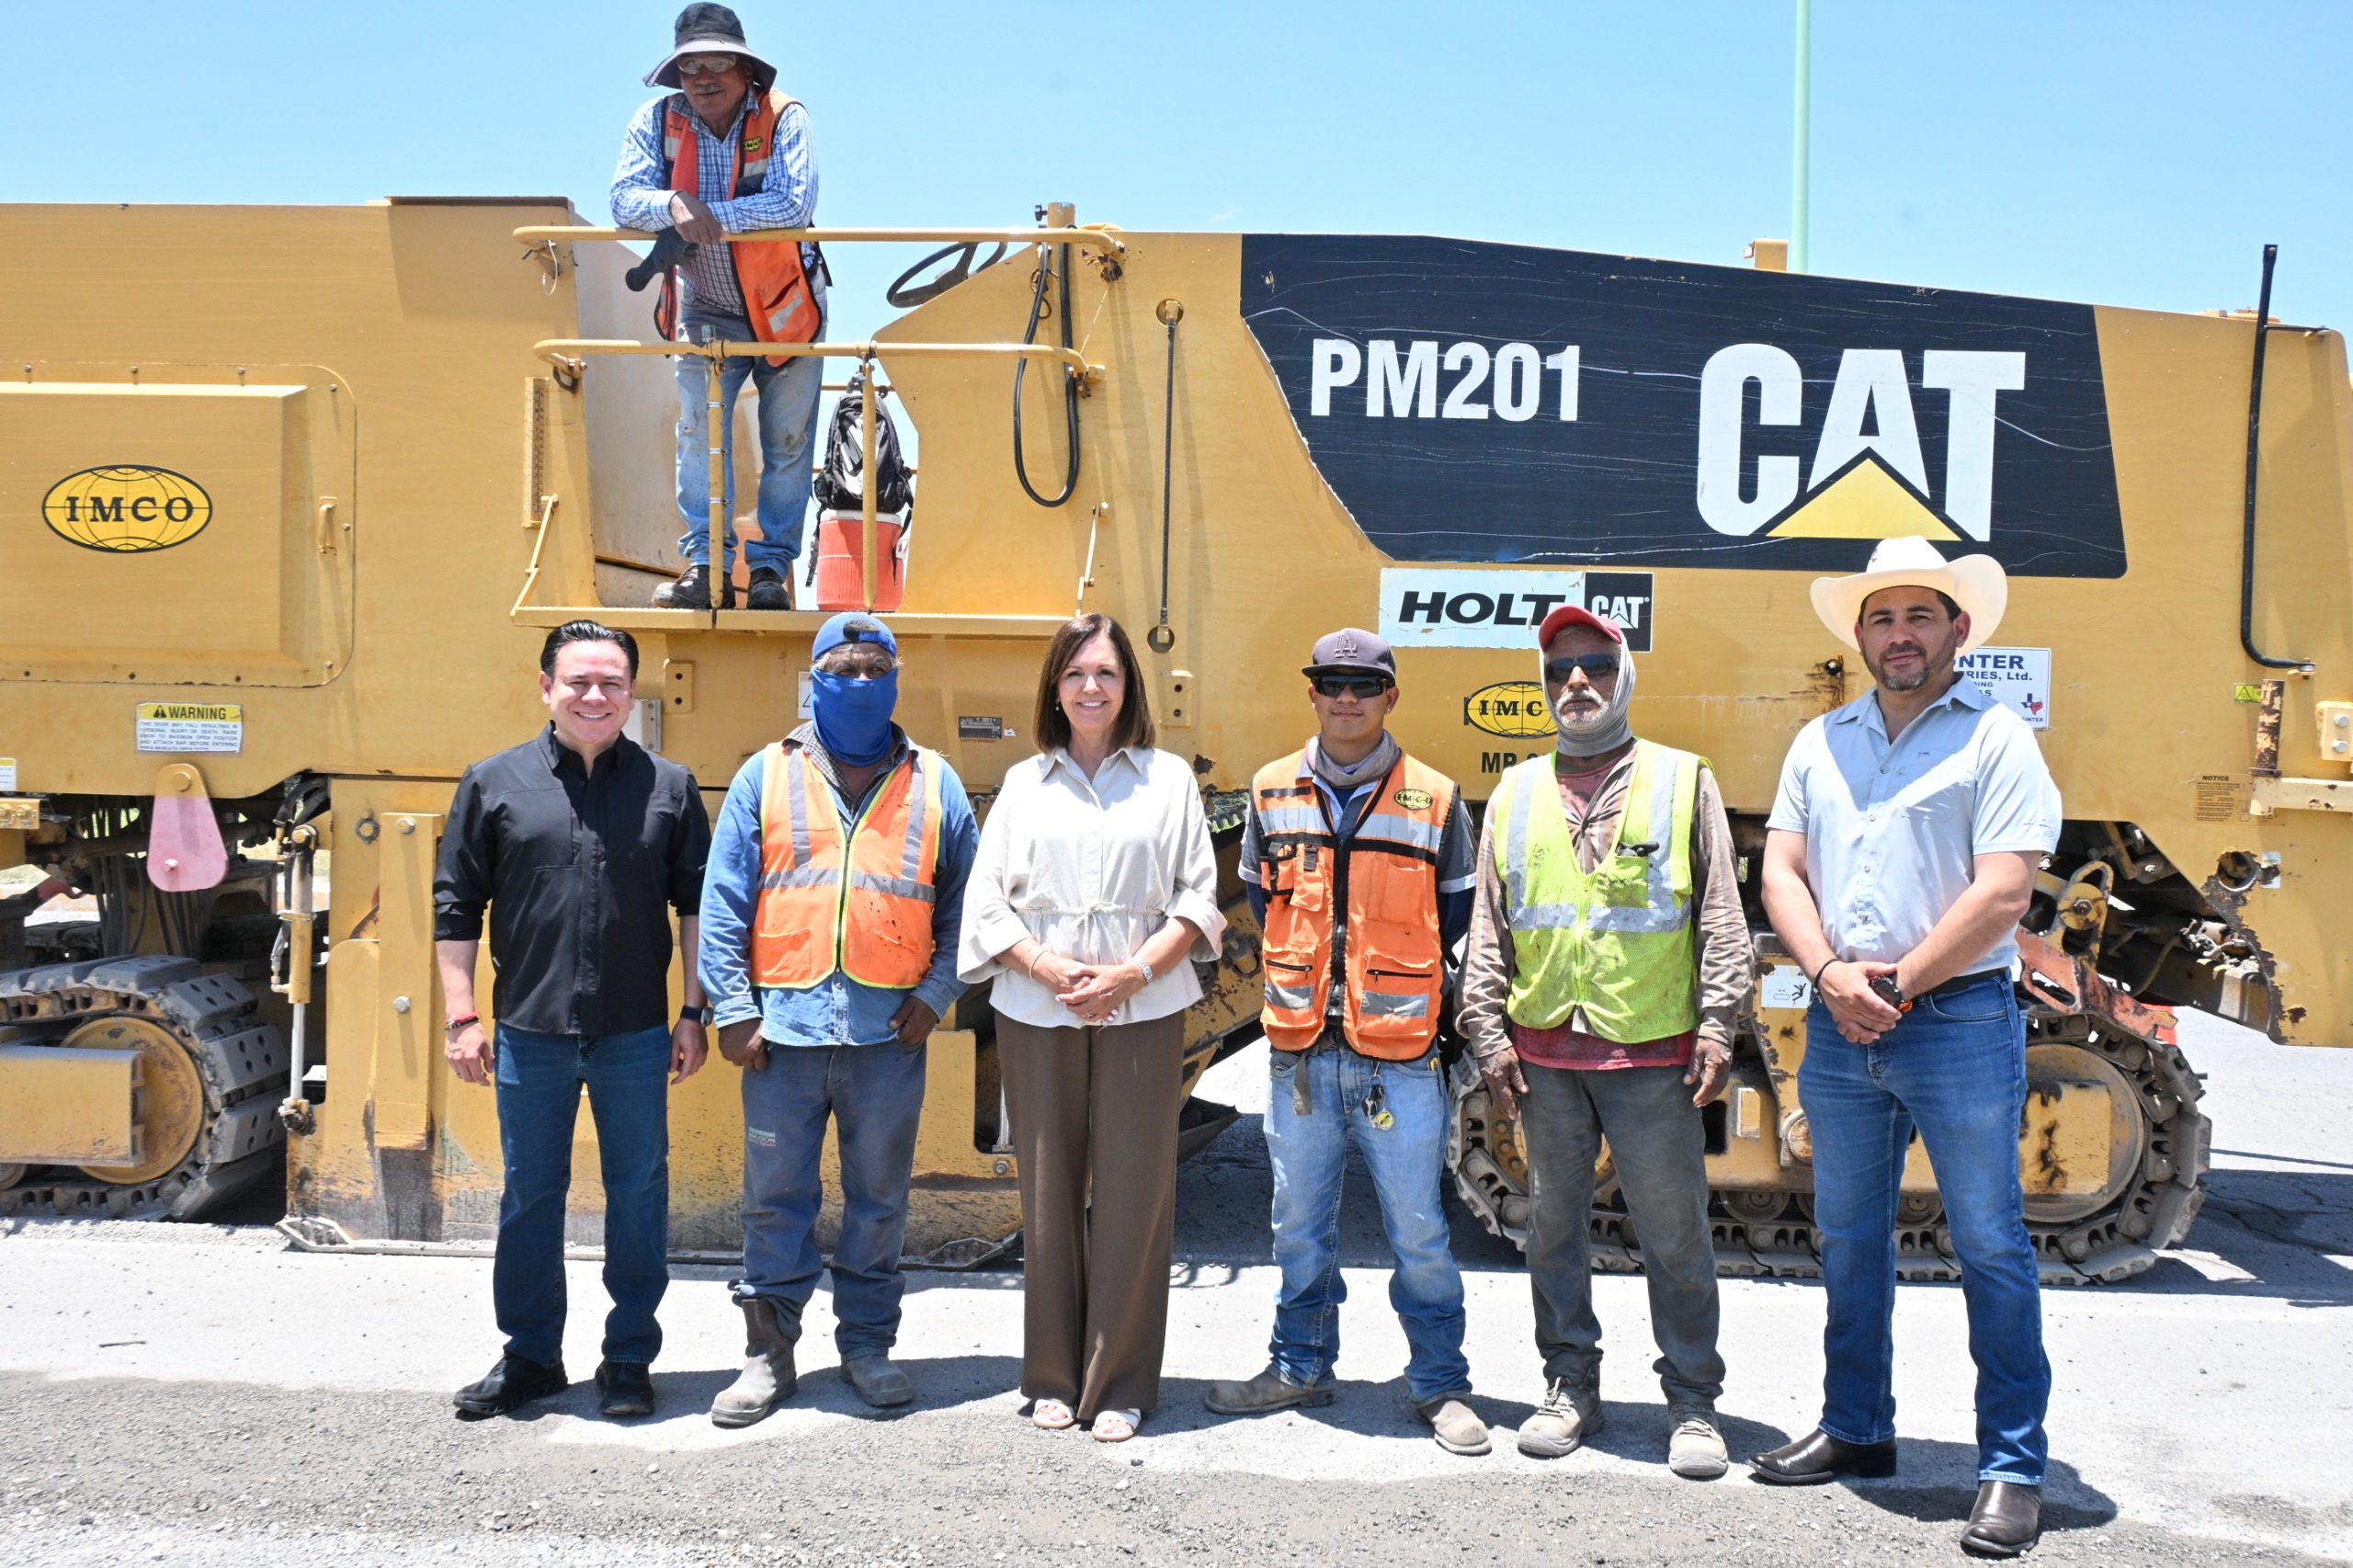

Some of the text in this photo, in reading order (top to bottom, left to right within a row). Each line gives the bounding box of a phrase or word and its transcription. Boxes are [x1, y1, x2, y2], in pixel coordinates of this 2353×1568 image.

[1311, 338, 1580, 422] PM201
[1697, 343, 2026, 542] CAT
[66, 496, 194, 522] IMCO
[1399, 591, 1567, 626] HOLT
[1956, 654, 2024, 669] NTER
[1967, 671, 2032, 681] RIES, Ltd.
[168, 706, 226, 720] WARNING
[1479, 700, 1542, 716] IMC
[1397, 794, 1431, 805] IMCO
